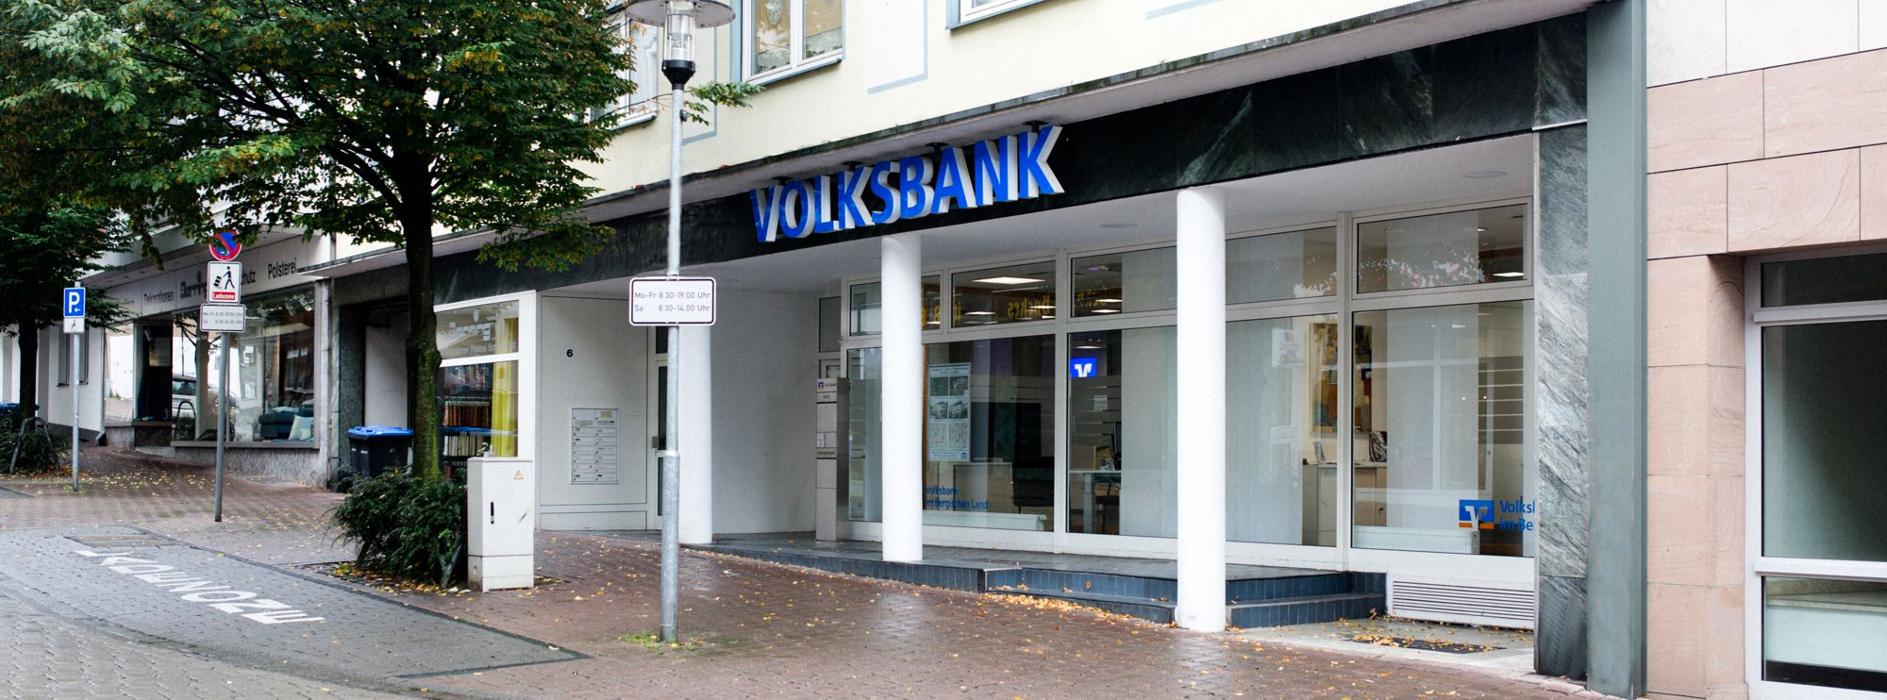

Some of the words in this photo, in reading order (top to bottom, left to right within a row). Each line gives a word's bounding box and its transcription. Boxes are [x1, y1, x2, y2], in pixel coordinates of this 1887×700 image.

[750, 125, 1065, 242] VOLKSBANK
[268, 257, 297, 280] Polsterei
[69, 291, 80, 313] P
[634, 291, 656, 299] Mo-Fr
[697, 291, 711, 299] Uhr
[634, 304, 644, 312] Sa
[697, 304, 711, 312] Uhr
[566, 348, 574, 358] 6
[71, 549, 326, 625] LADEZONE
